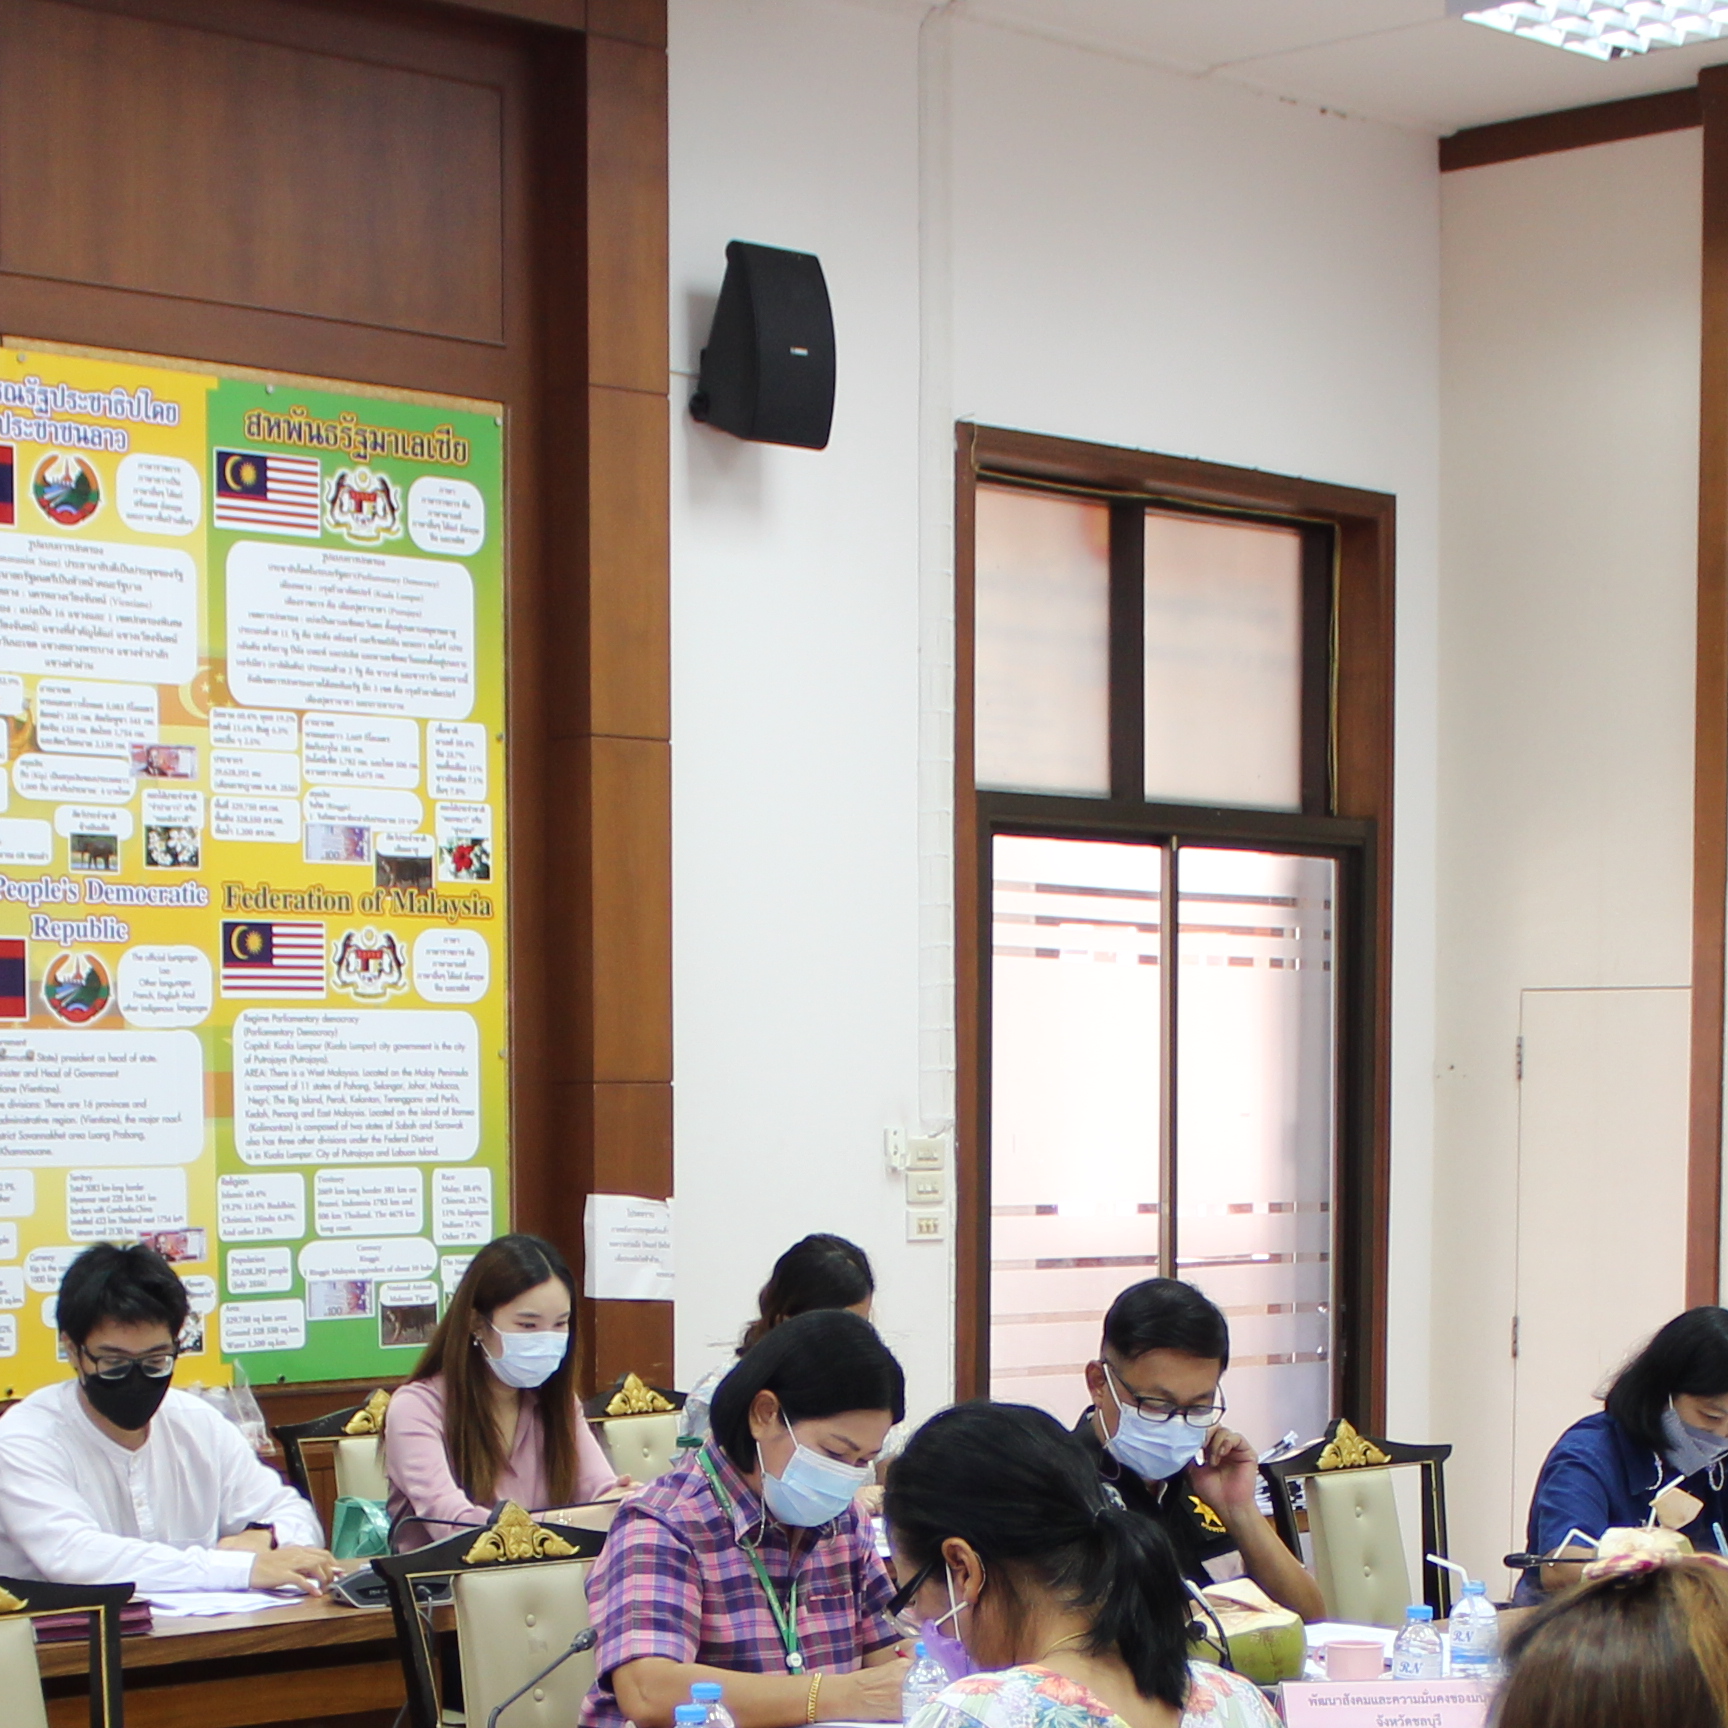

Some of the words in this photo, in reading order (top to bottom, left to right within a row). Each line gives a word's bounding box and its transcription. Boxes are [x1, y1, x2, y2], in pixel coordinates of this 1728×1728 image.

[243, 406, 470, 466] สหพันธรัฐมาเลเซีย
[85, 877, 209, 906] Democratic
[222, 881, 351, 913] Federation
[360, 891, 384, 914] of
[390, 889, 493, 922] Malaysia
[31, 915, 128, 946] Republic
